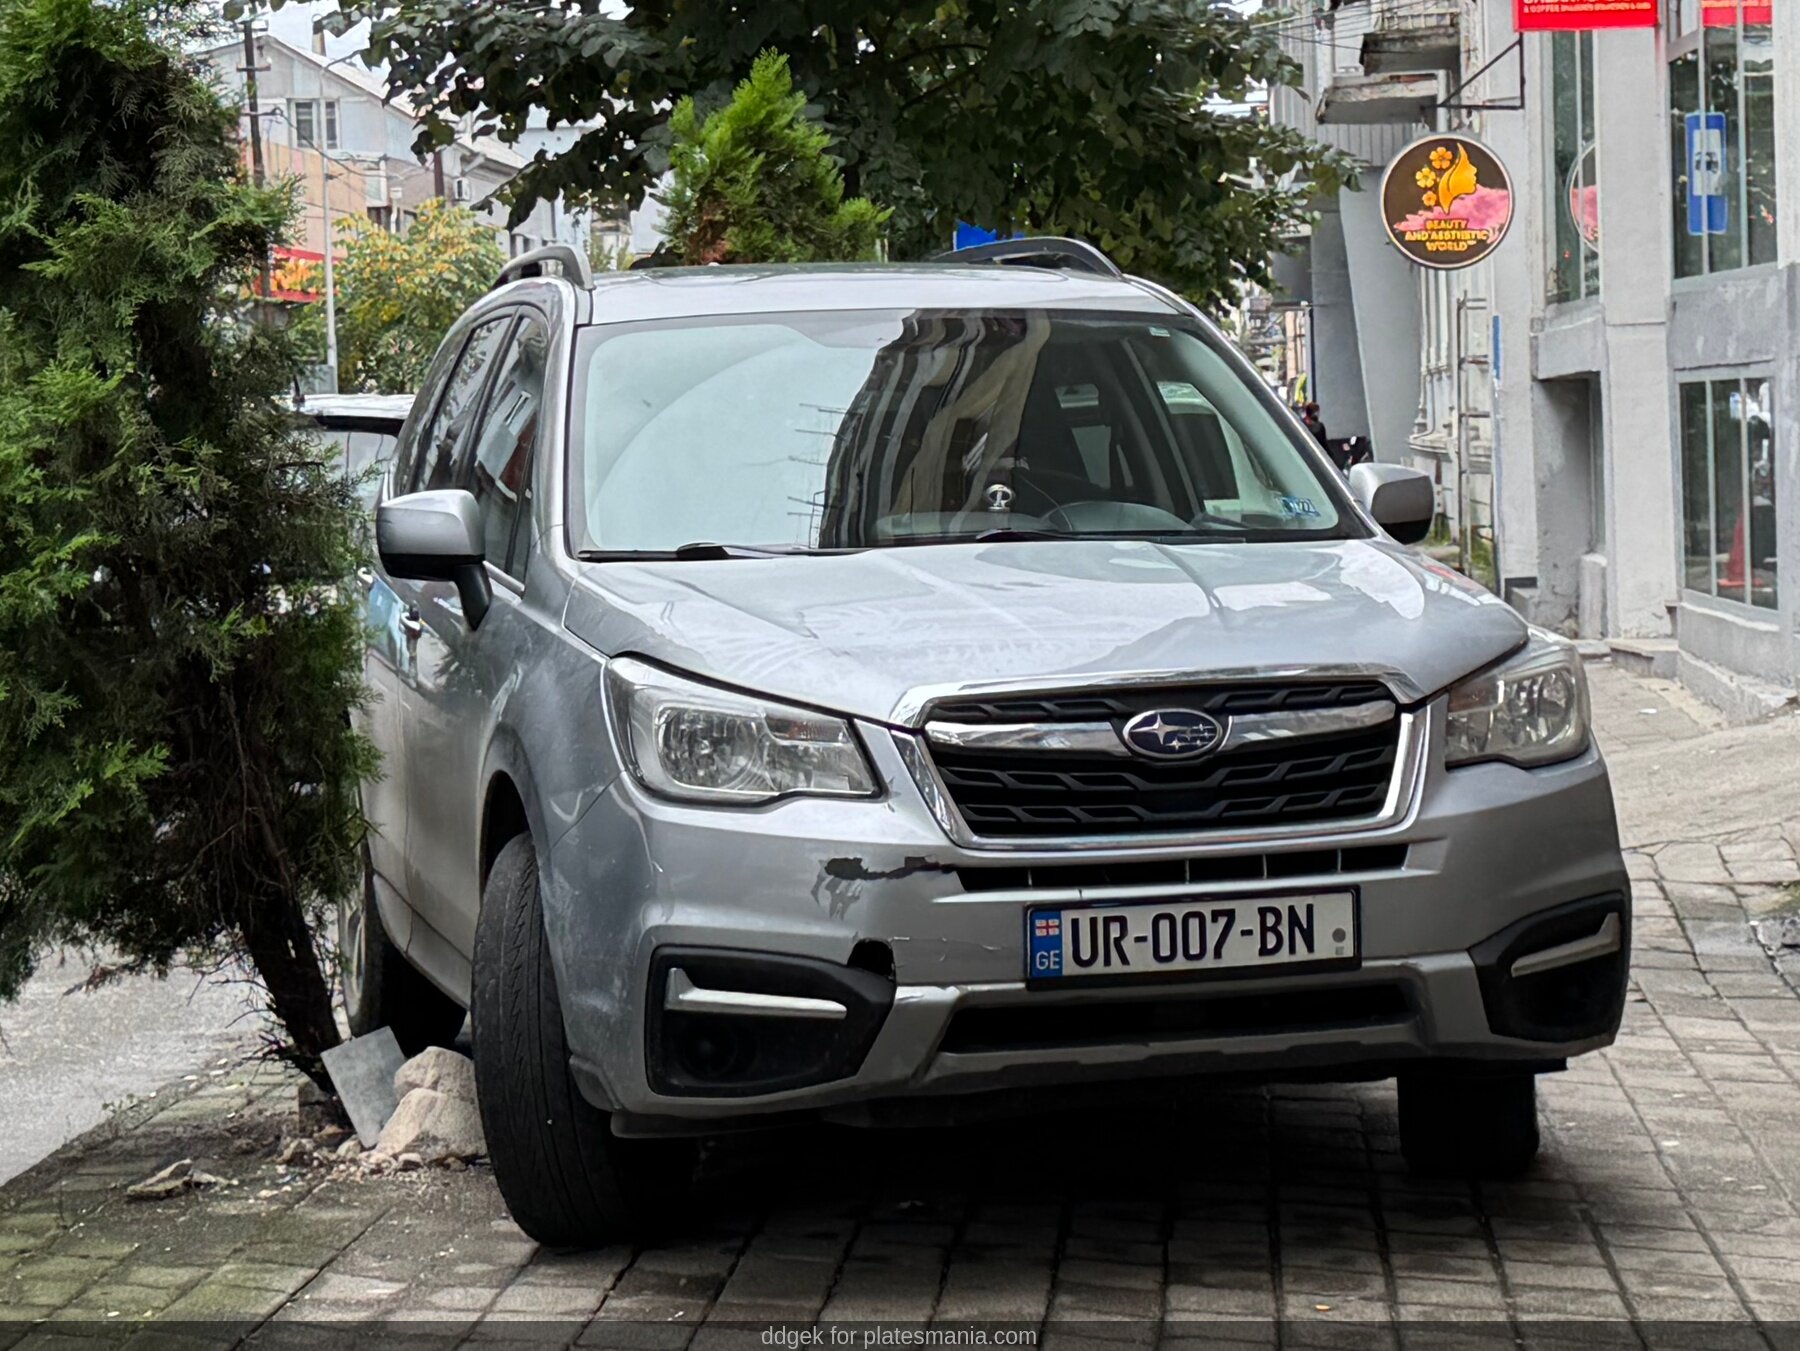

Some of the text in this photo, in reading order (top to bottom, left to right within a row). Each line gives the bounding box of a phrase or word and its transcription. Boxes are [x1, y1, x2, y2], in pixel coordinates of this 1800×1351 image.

[1426, 220, 1467, 230] BEAUTY
[1405, 231, 1429, 241] AND
[1426, 241, 1468, 251] WORLD
[1071, 903, 1315, 968] UR-007-BN
[1035, 950, 1061, 970] GE
